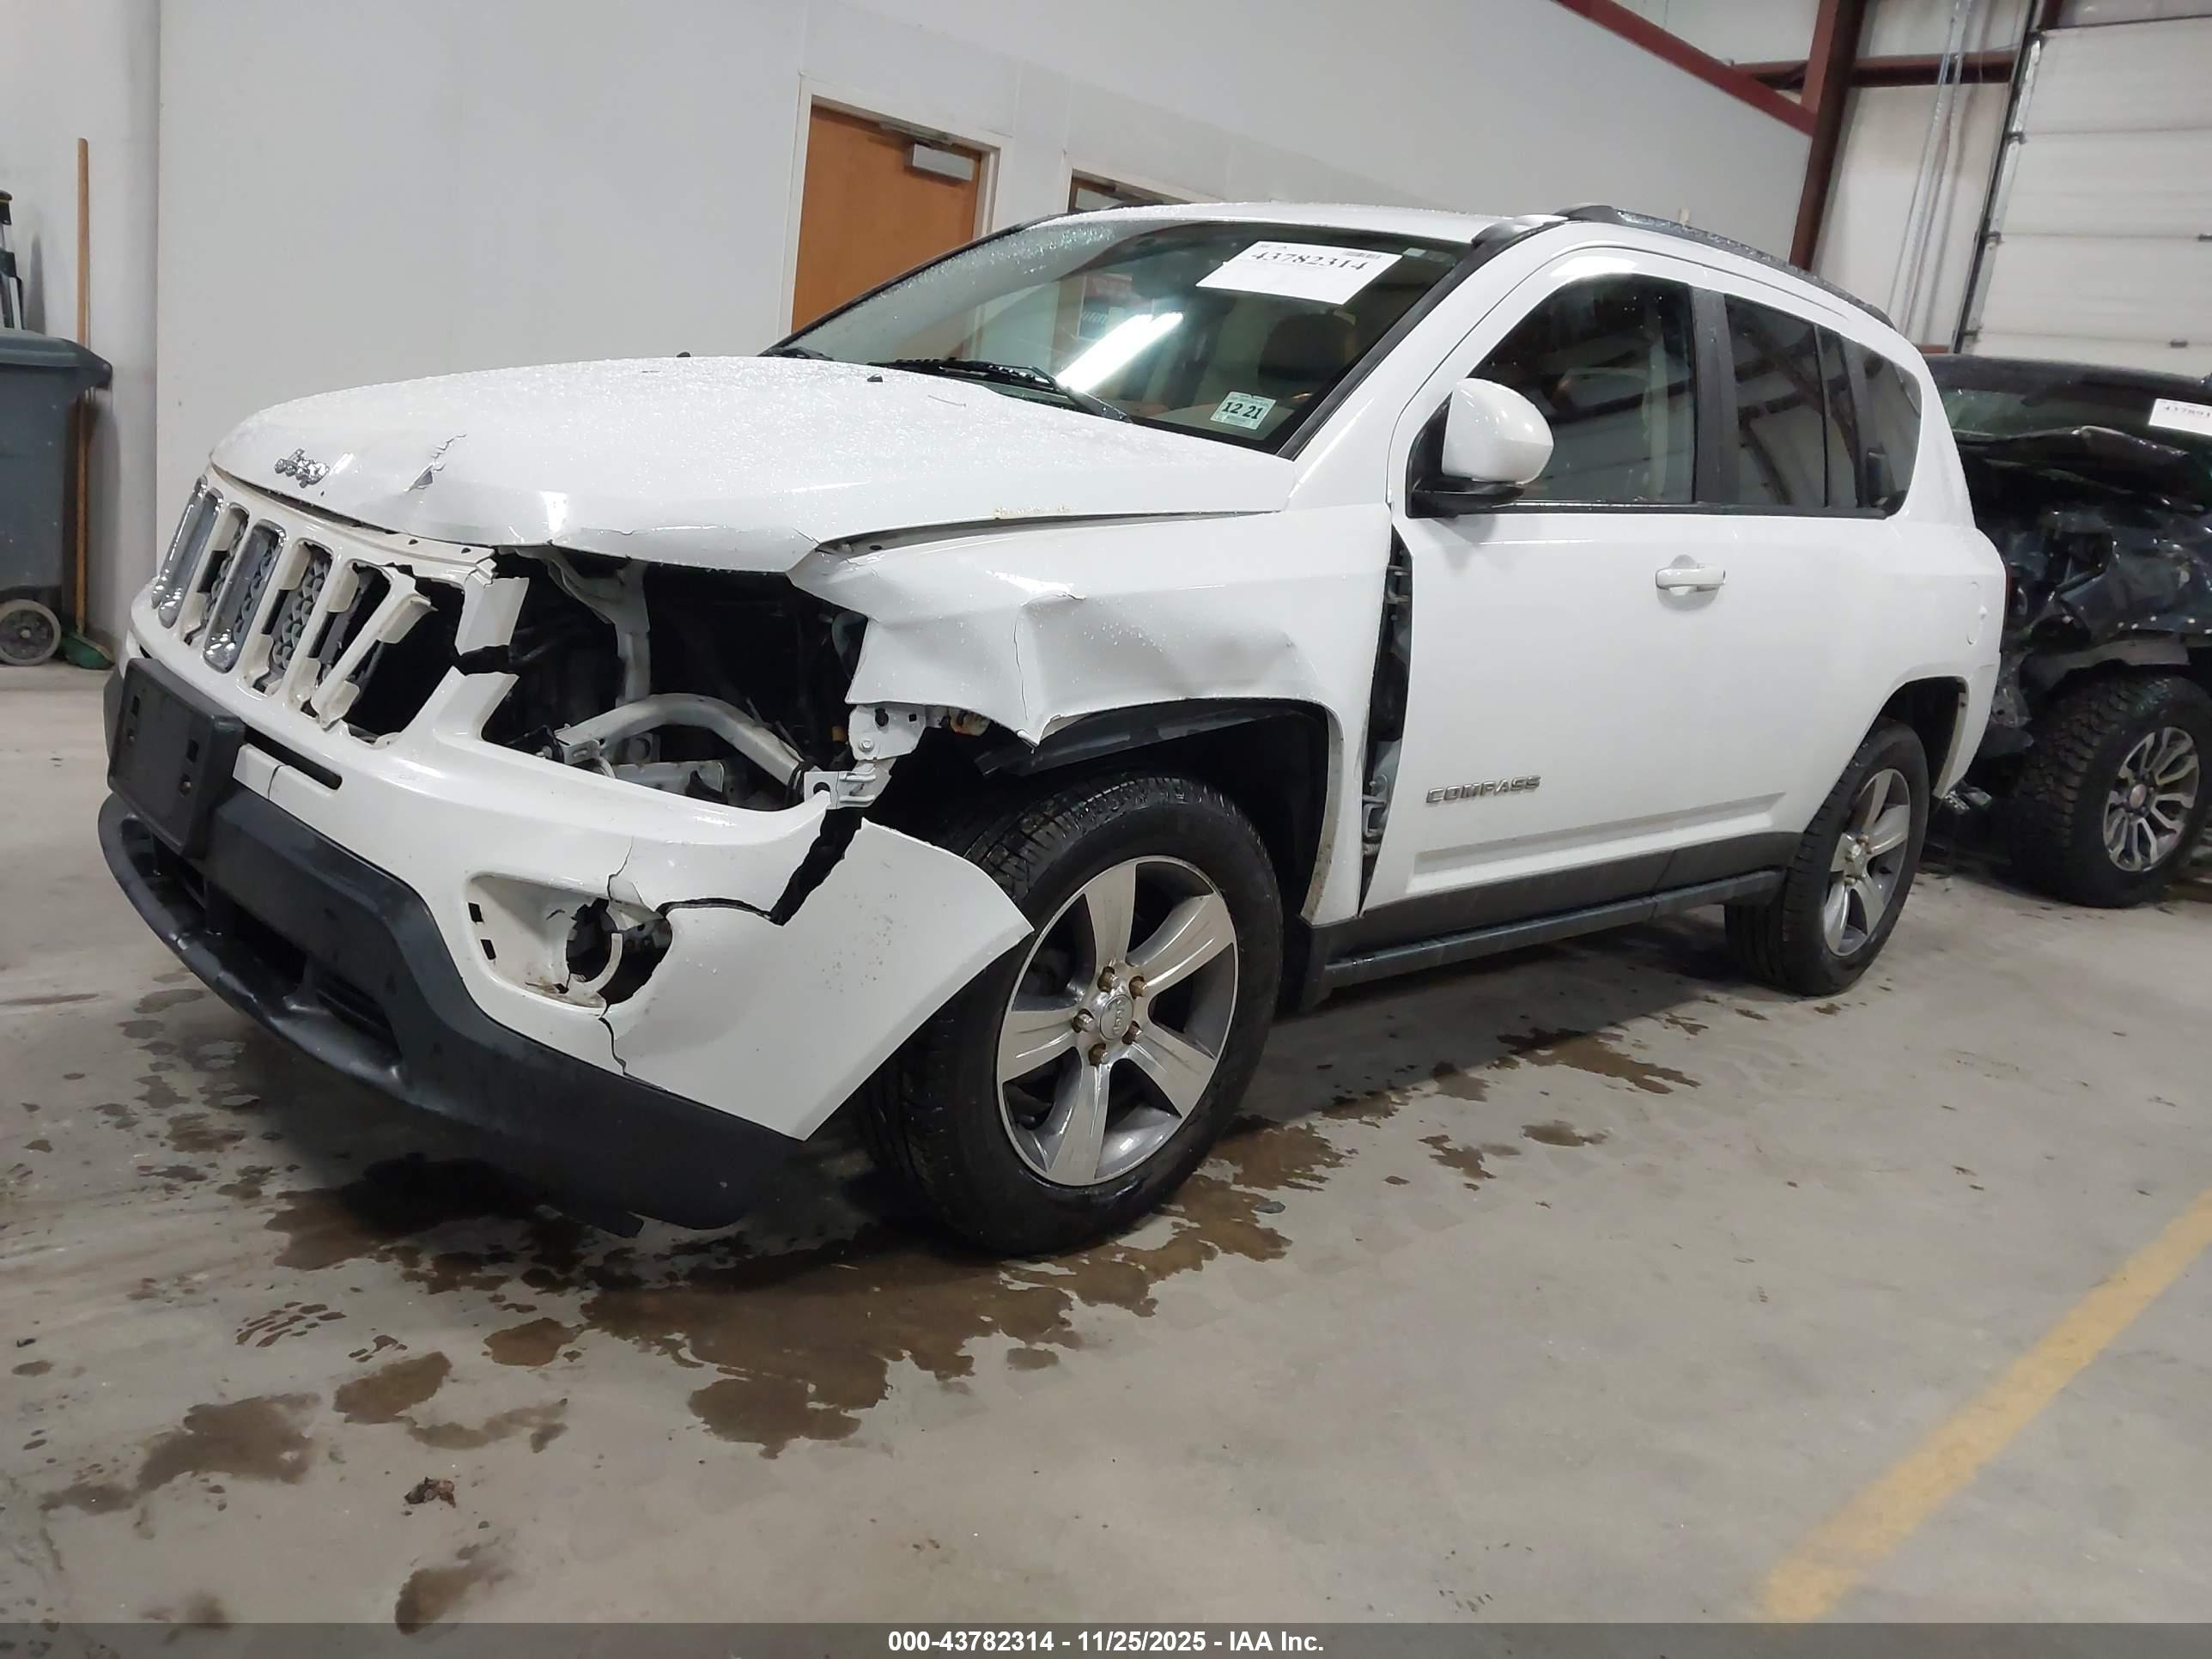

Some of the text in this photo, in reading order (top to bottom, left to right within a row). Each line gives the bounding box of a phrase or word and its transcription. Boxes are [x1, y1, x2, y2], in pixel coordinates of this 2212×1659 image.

[1253, 251, 1368, 270] 43782314
[1222, 401, 1243, 414] 12
[1243, 405, 1263, 420] 21
[1425, 775, 1541, 803] COMPASS
